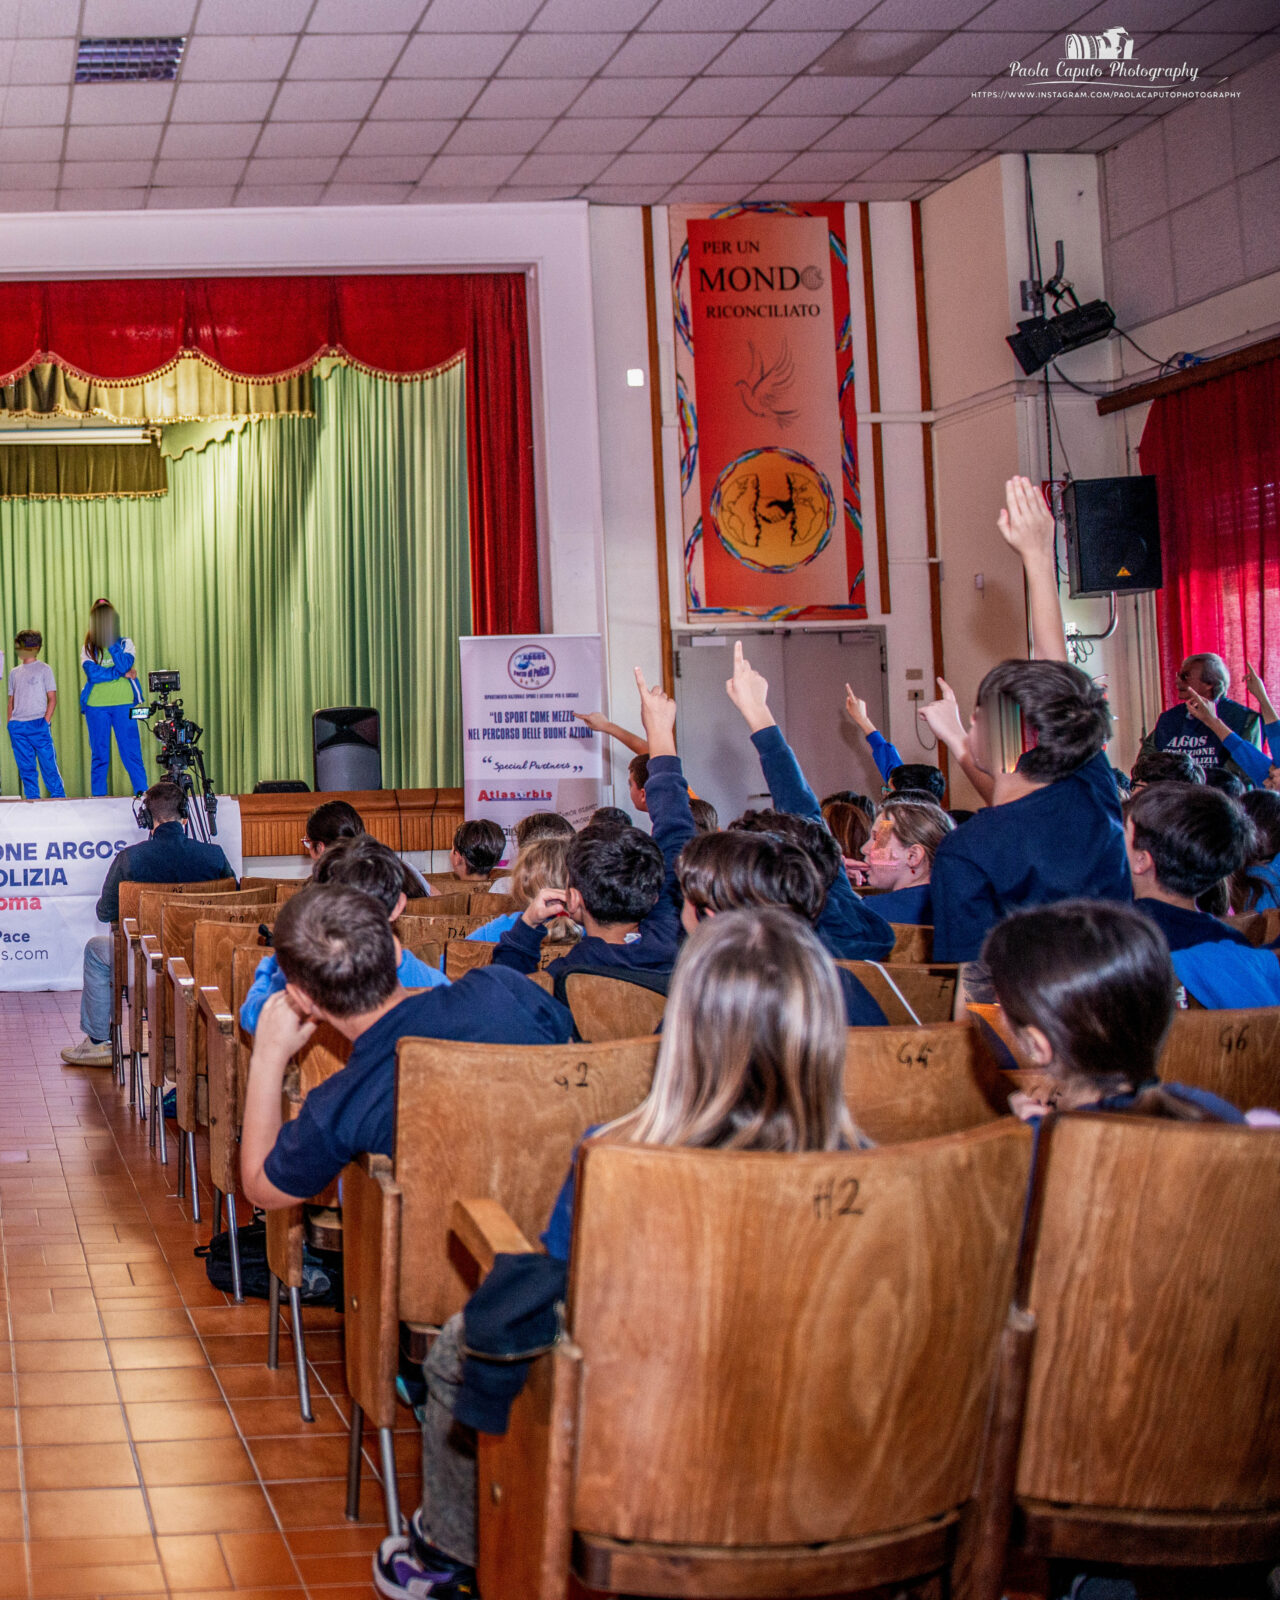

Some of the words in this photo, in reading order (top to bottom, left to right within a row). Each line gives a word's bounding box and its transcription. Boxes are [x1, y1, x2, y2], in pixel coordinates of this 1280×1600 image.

[703, 241, 732, 254] PER
[737, 241, 759, 253] UN
[706, 304, 820, 318] RICONCILIATO
[505, 711, 527, 723] SPORT
[530, 711, 549, 722] COME
[468, 729, 479, 740] NEL
[483, 728, 520, 739] PERCORSO
[522, 727, 541, 739] DELLE
[544, 727, 566, 738] BUONE
[494, 761, 527, 772] Special
[529, 761, 570, 769] Partners
